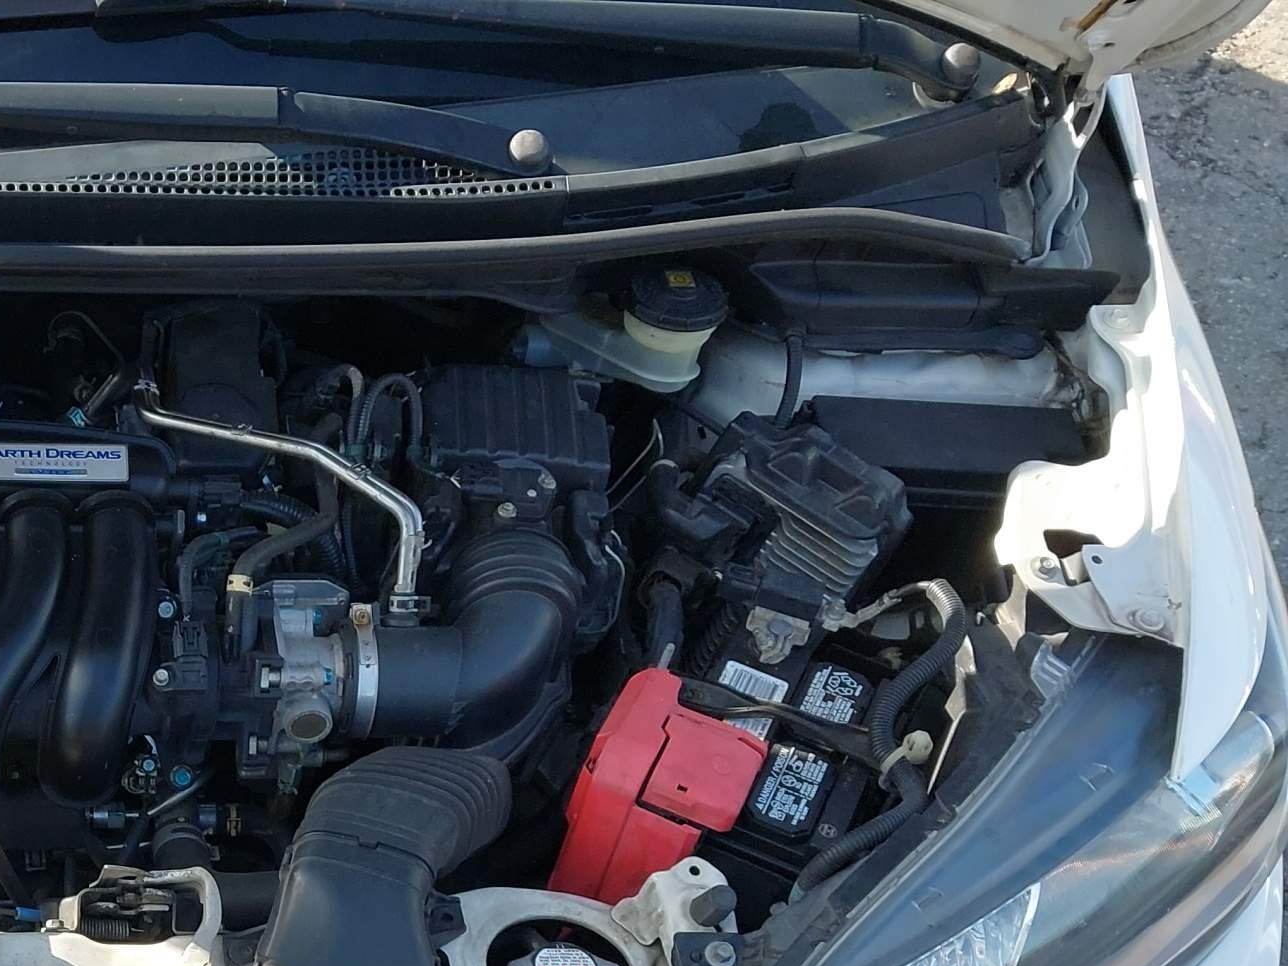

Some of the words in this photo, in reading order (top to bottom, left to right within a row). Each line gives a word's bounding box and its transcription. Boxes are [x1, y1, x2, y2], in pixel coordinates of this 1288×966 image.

[45, 448, 122, 460] DREAMS
[757, 776, 777, 804] DANGER
[772, 747, 790, 773] POISON
